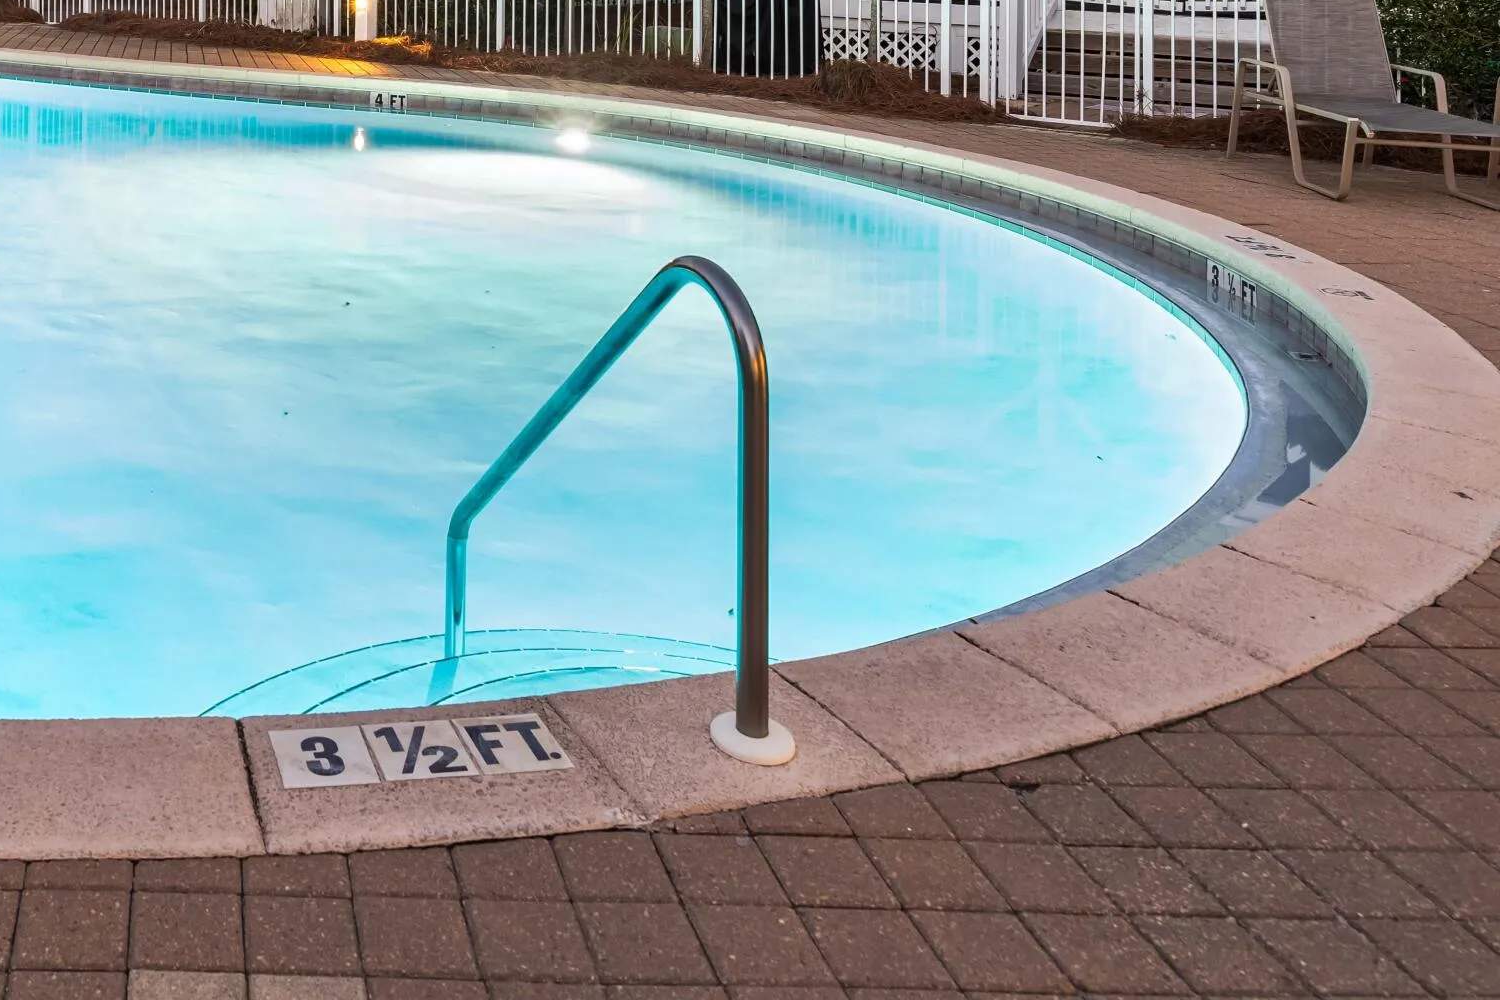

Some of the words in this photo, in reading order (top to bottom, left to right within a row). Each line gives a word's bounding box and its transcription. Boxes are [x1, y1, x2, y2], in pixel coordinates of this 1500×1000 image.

[375, 94, 383, 105] 4
[390, 94, 406, 107] FT
[1211, 265, 1220, 287] 3
[1241, 279, 1256, 307] FT
[300, 736, 346, 777] 3
[463, 721, 562, 766] FT.
